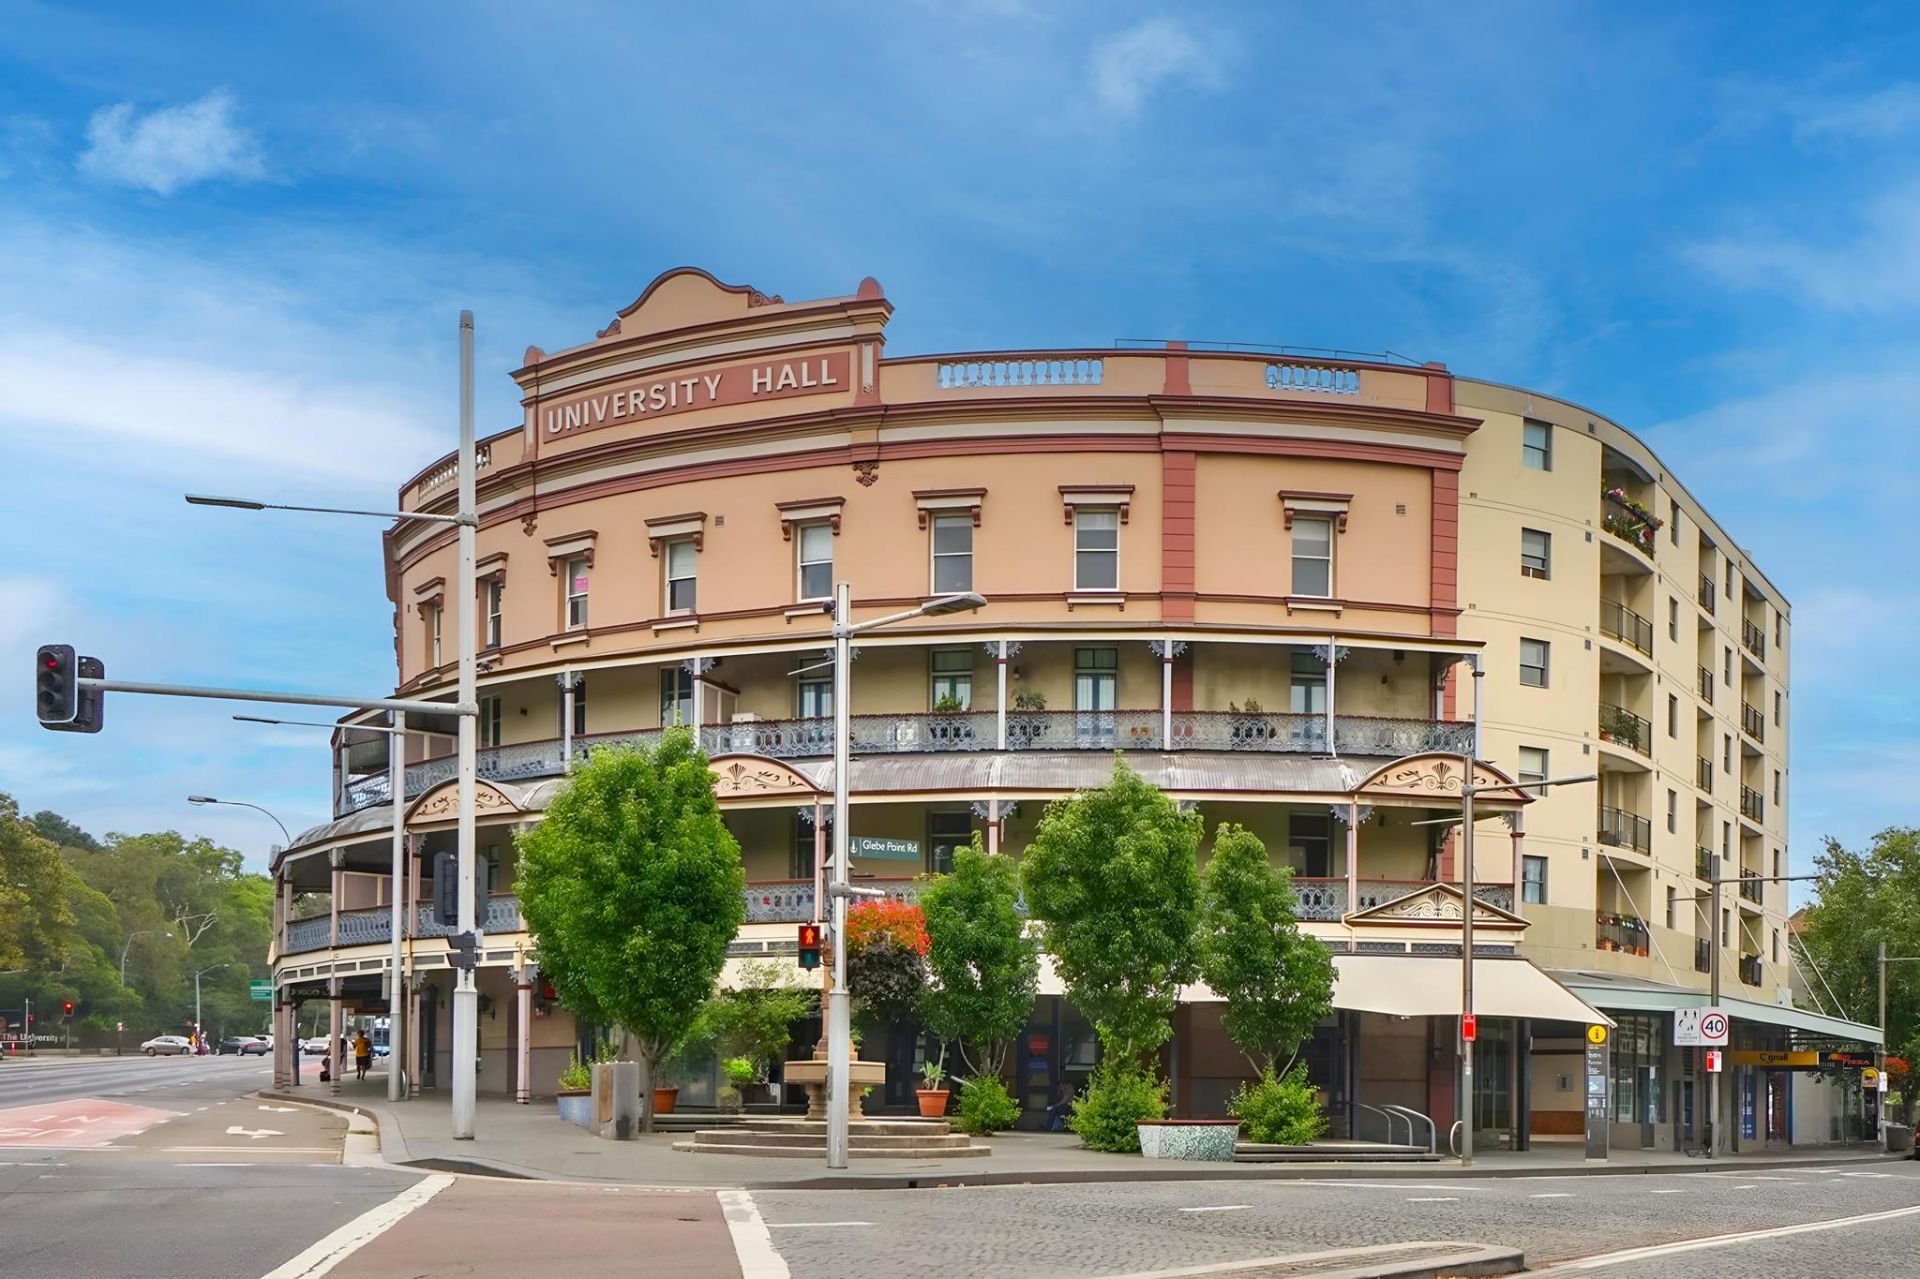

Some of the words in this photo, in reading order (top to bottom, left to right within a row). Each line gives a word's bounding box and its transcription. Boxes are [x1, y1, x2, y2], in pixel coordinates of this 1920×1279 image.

[547, 373, 723, 434] UNIVERSITY
[751, 358, 838, 394] HALL
[862, 839, 885, 851] Glebe
[907, 843, 918, 853] Rd
[1705, 1019, 1724, 1033] 40
